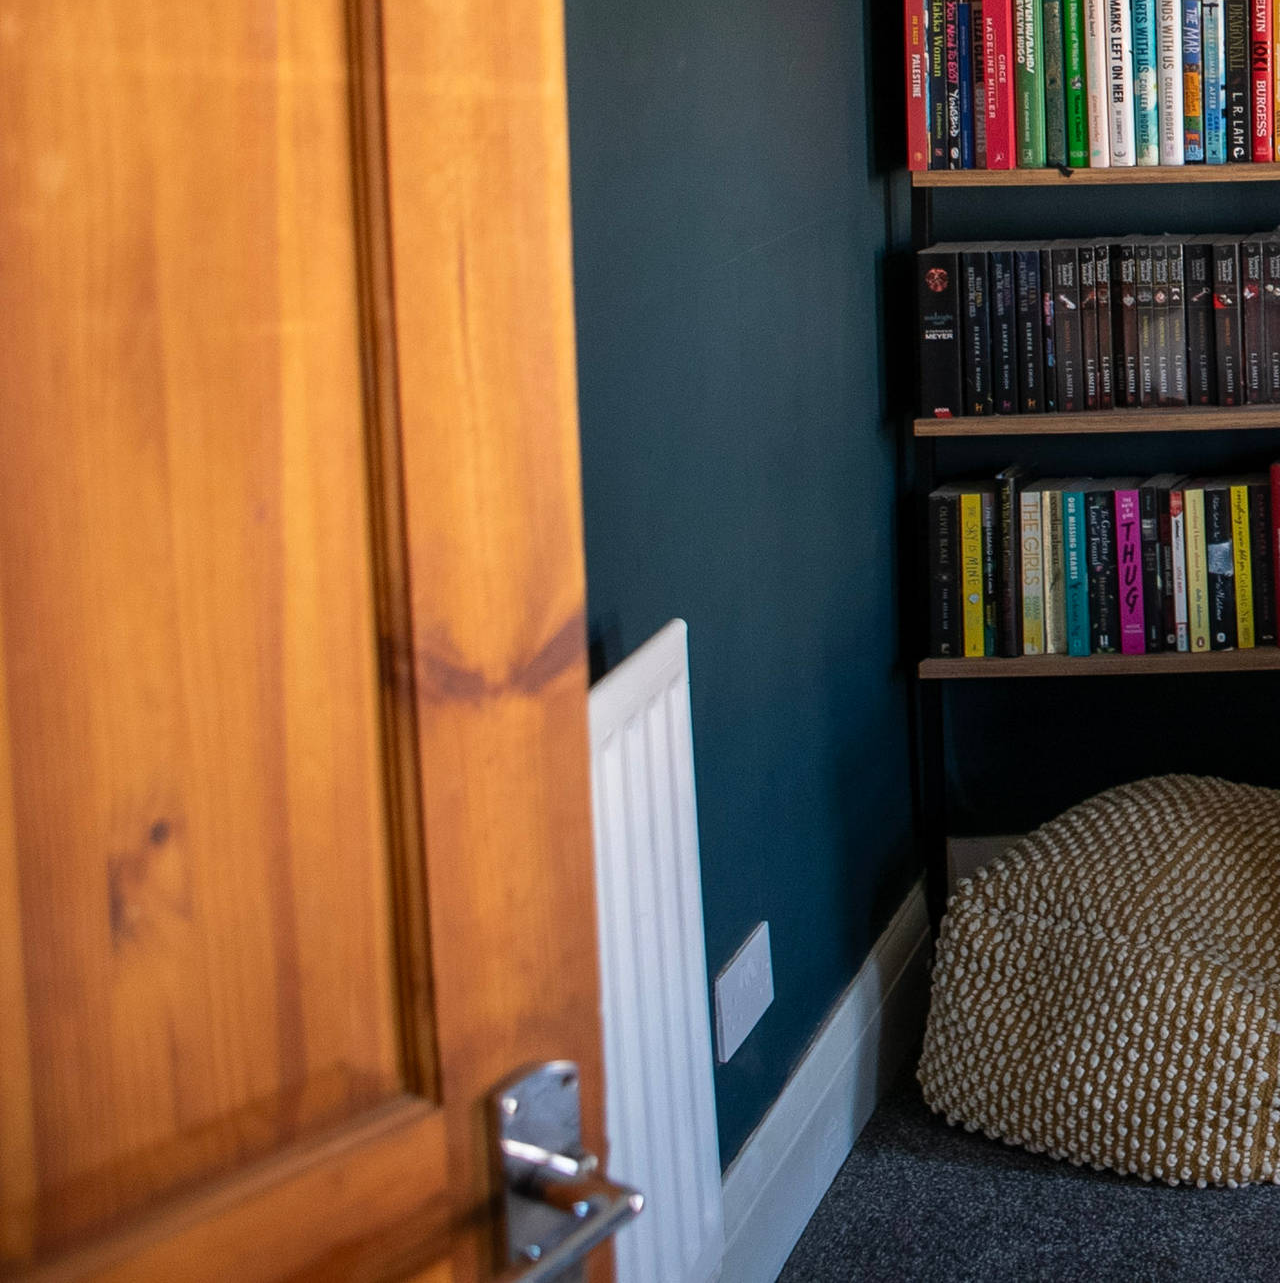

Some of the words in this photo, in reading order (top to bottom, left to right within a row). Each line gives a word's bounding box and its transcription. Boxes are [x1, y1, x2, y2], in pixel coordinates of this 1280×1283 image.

[1016, 0, 1025, 34] EVELYN
[1186, 7, 1198, 24] THE
[985, 17, 996, 74] MADELINE
[1017, 35, 1025, 64] HUGO
[1025, 22, 1035, 74] HUSBANDS
[1111, 37, 1122, 61] LEFT
[1136, 27, 1148, 54] WITH
[1163, 25, 1174, 53] WITH
[1207, 23, 1216, 47] EVERY
[1229, 4, 1245, 71] DRAGONFALL
[934, 35, 943, 77] Woman
[998, 54, 1007, 83] CIRCE
[1137, 59, 1149, 73] US
[1163, 56, 1174, 70] US
[1208, 49, 1216, 84] SUMMER
[1253, 41, 1271, 73] LOKI
[912, 53, 921, 98] PALESTINE
[1112, 65, 1123, 80] ON
[988, 78, 997, 119] MILLER
[1112, 83, 1124, 103] HER
[1139, 78, 1148, 111] COLLEEN
[1165, 77, 1173, 109] COLLEEN
[1208, 86, 1217, 110] AFTER
[1256, 80, 1267, 137] BURGESS
[1140, 113, 1149, 144] HOOVER
[1166, 111, 1175, 141] HOOVER
[1233, 120, 1243, 144] LAM
[925, 332, 954, 340] MEYER
[1066, 373, 1074, 398] SMITH
[1088, 372, 1096, 395] SMITH
[1103, 369, 1112, 393] SMITH
[1128, 368, 1136, 393] SMITH
[1144, 368, 1152, 392] SMITH
[1160, 369, 1168, 392] SMITH
[1176, 367, 1184, 391] SMITH
[1023, 502, 1040, 531] THE
[1067, 497, 1077, 514] OUR
[1089, 505, 1099, 524] Lost
[965, 521, 978, 541] SKY
[986, 521, 994, 555] MERMAID
[1068, 516, 1077, 549] MISSING
[1101, 520, 1111, 550] Garden
[940, 538, 950, 564] BLAKE
[1024, 537, 1040, 586] GIRLS
[1052, 533, 1061, 565] ahern
[1091, 537, 1101, 566] Found
[966, 556, 979, 585] MINE
[1069, 551, 1078, 580] HEARTS
[1121, 521, 1139, 614] THUG
